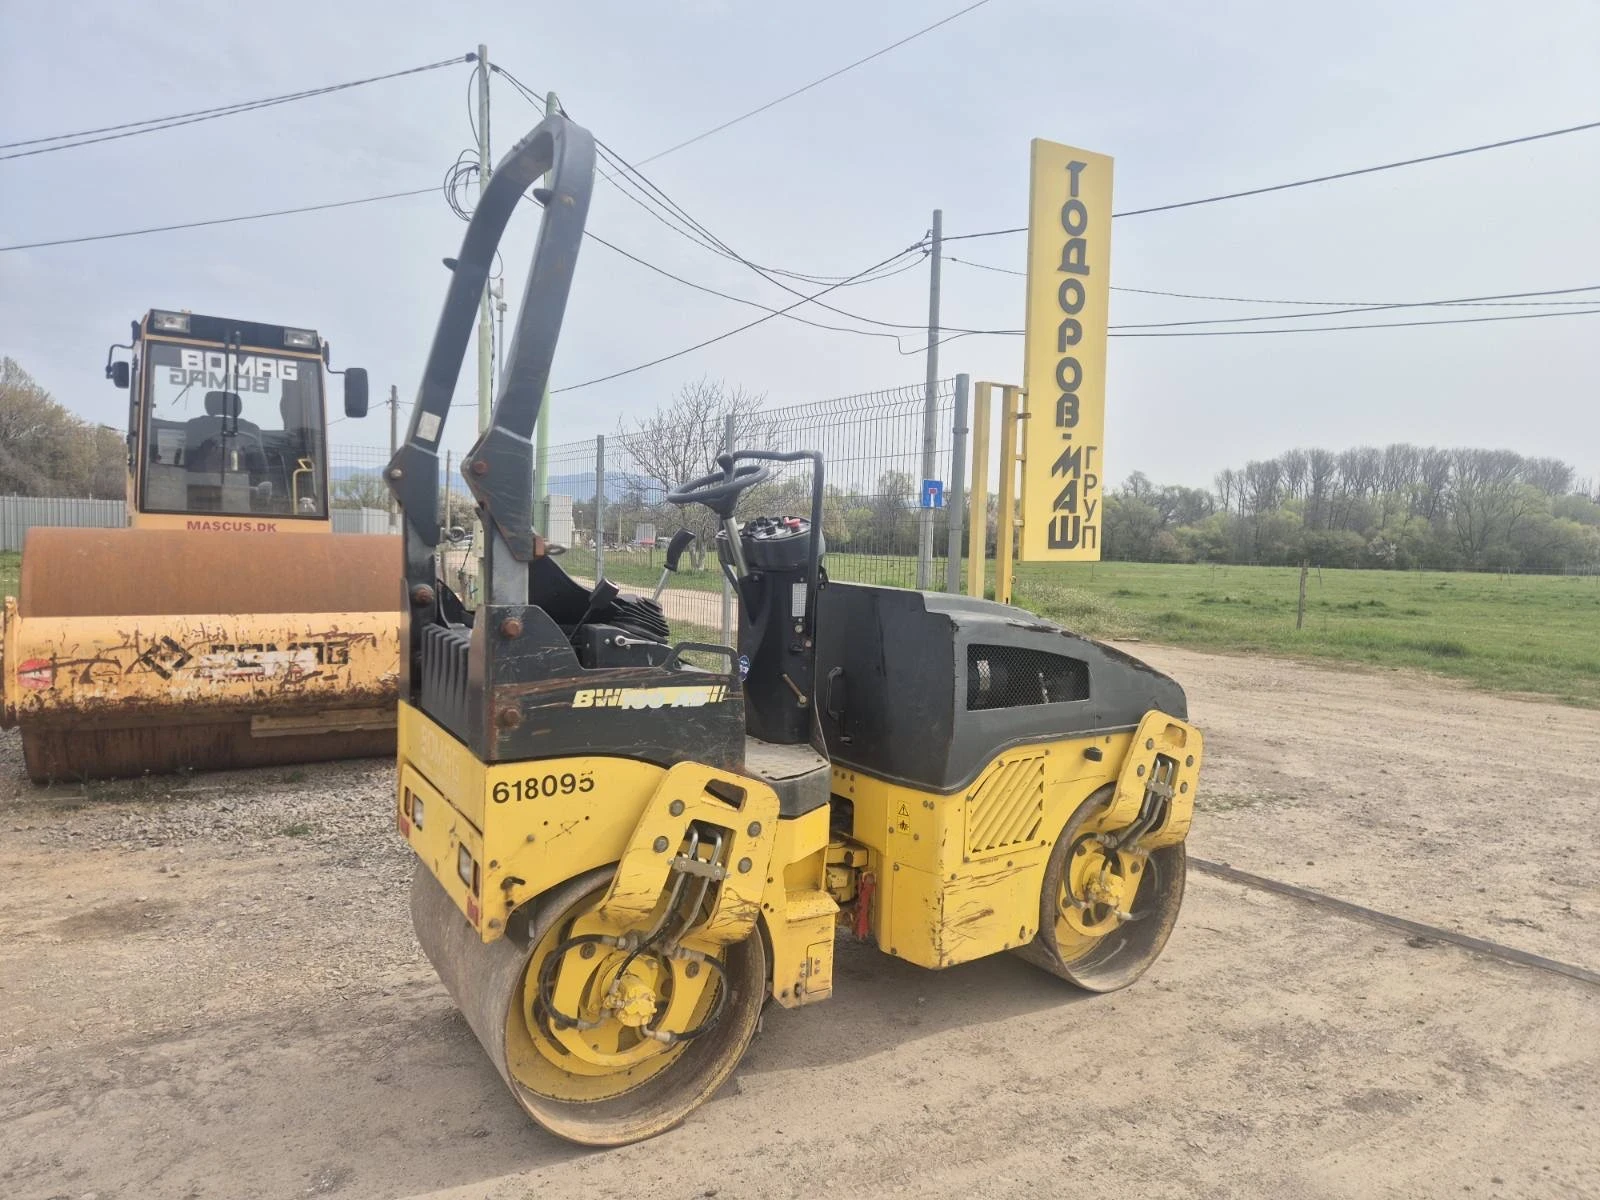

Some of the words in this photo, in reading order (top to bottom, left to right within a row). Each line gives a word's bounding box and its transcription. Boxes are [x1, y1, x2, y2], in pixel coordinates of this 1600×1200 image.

[181, 348, 298, 381] BOMAG
[1047, 160, 1090, 549] ТОДОРОВ-МАШ
[1081, 445, 1098, 549] ГРУП
[186, 520, 277, 533] MASCUS.DK
[492, 771, 595, 804] 618095
